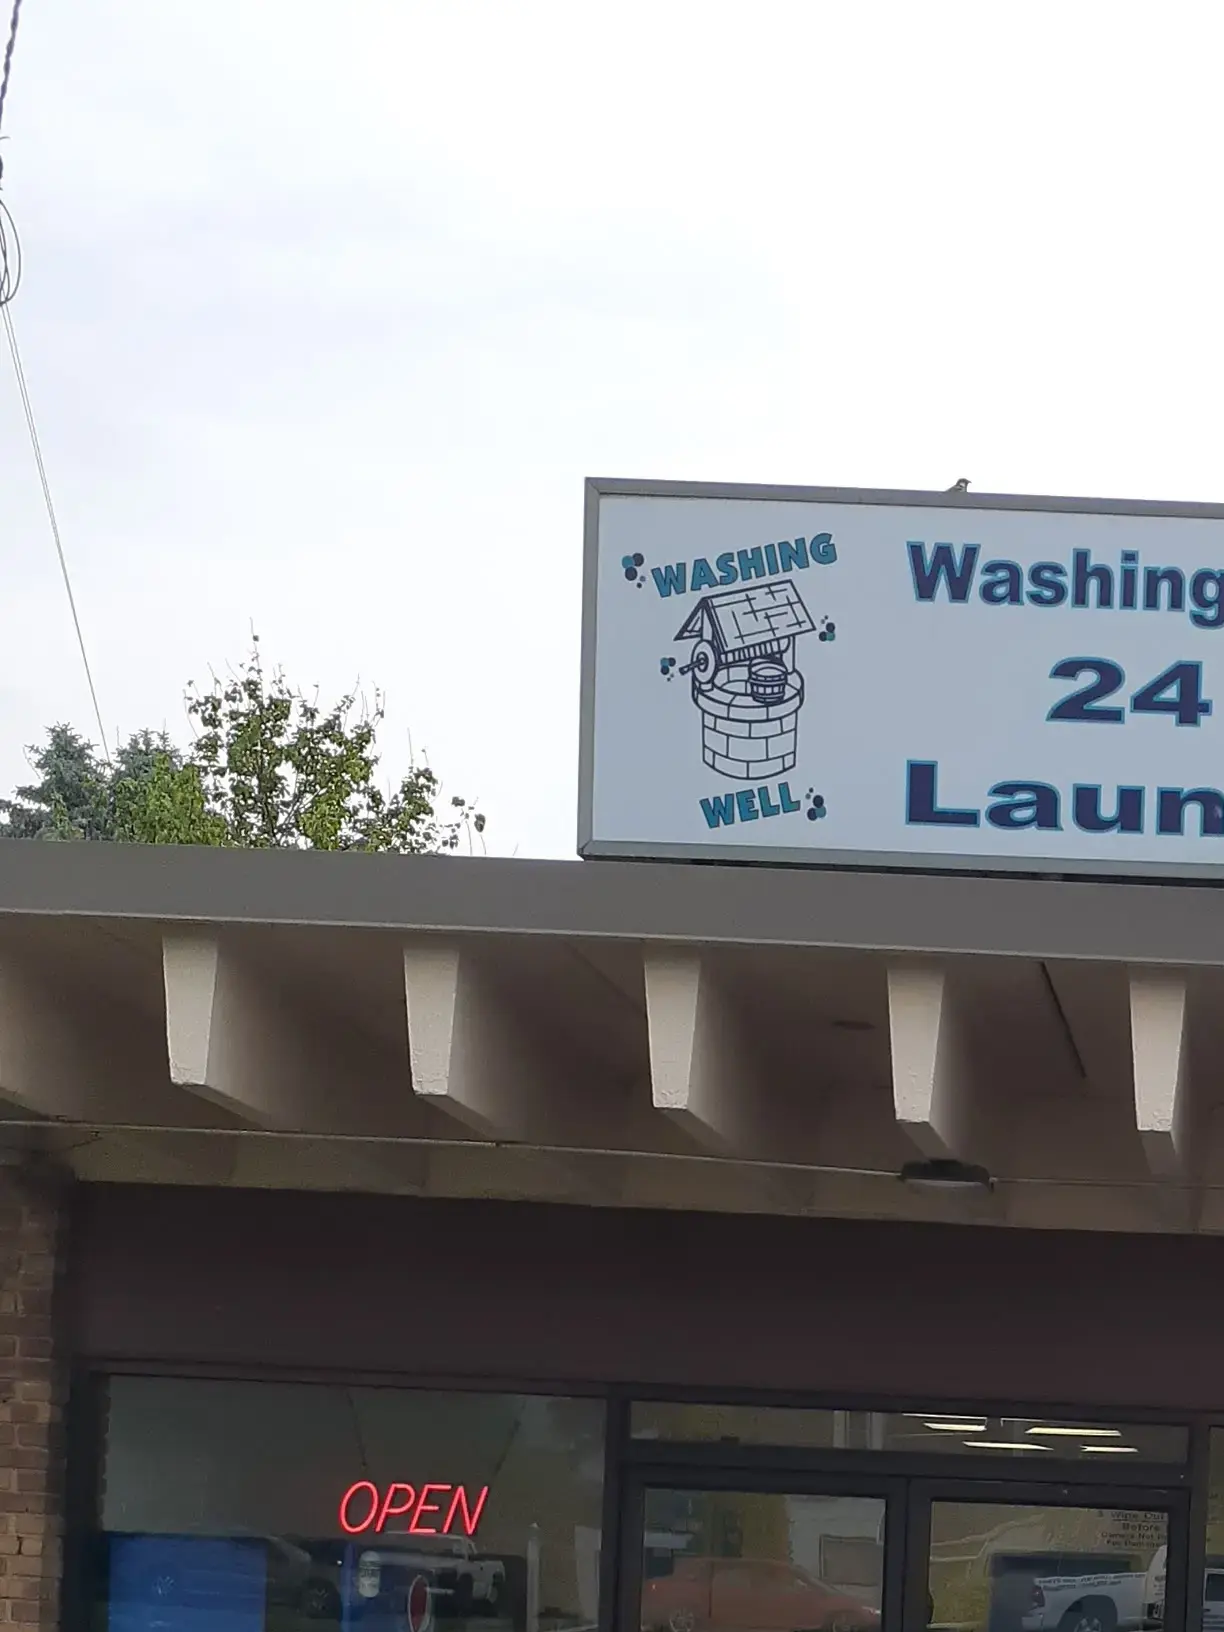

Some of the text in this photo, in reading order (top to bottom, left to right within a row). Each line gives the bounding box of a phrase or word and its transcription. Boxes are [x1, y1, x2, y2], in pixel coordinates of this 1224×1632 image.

[651, 532, 838, 599] WASHING
[1045, 655, 1213, 728] 24
[699, 780, 802, 830] WELL
[338, 1480, 489, 1537] OPEN
